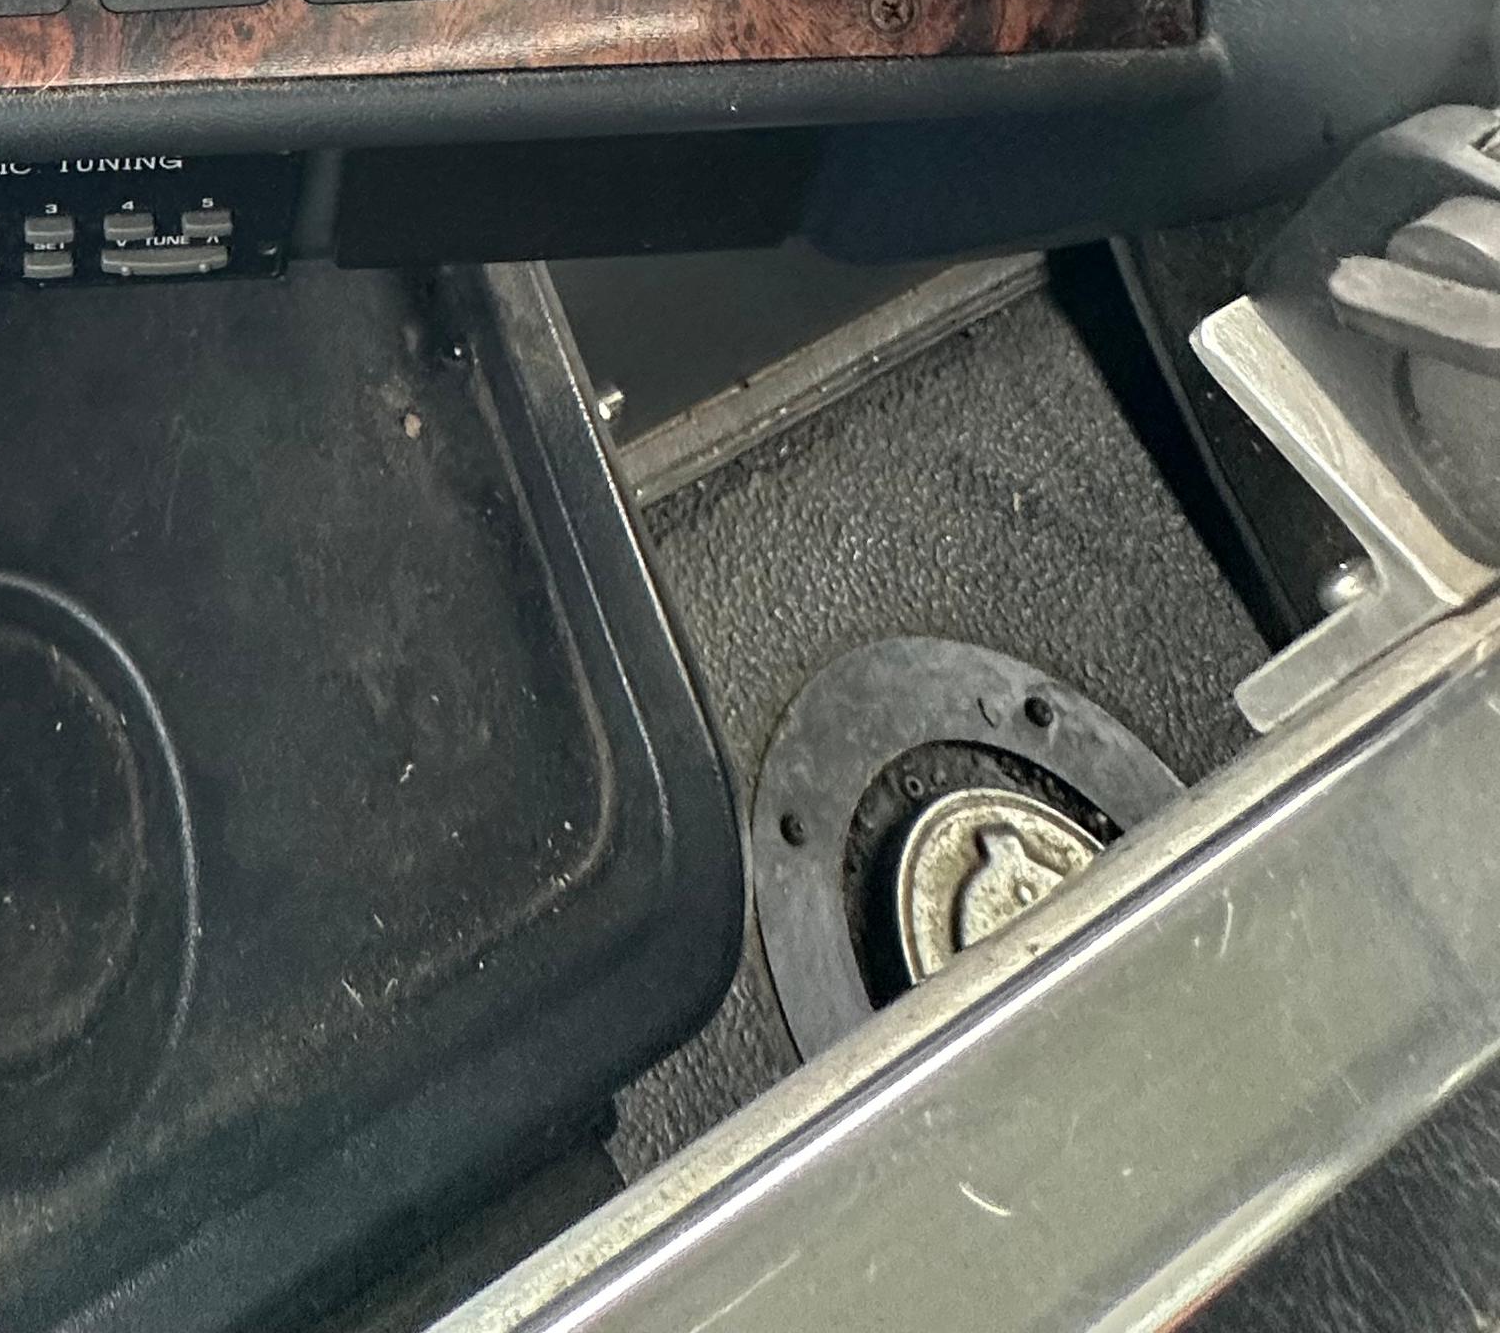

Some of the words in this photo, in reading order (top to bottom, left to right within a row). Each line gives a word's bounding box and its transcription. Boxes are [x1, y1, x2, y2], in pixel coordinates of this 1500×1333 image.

[46, 204, 58, 214] 3
[122, 201, 134, 210] 4
[202, 197, 214, 207] 5
[146, 235, 190, 246] TUNE
